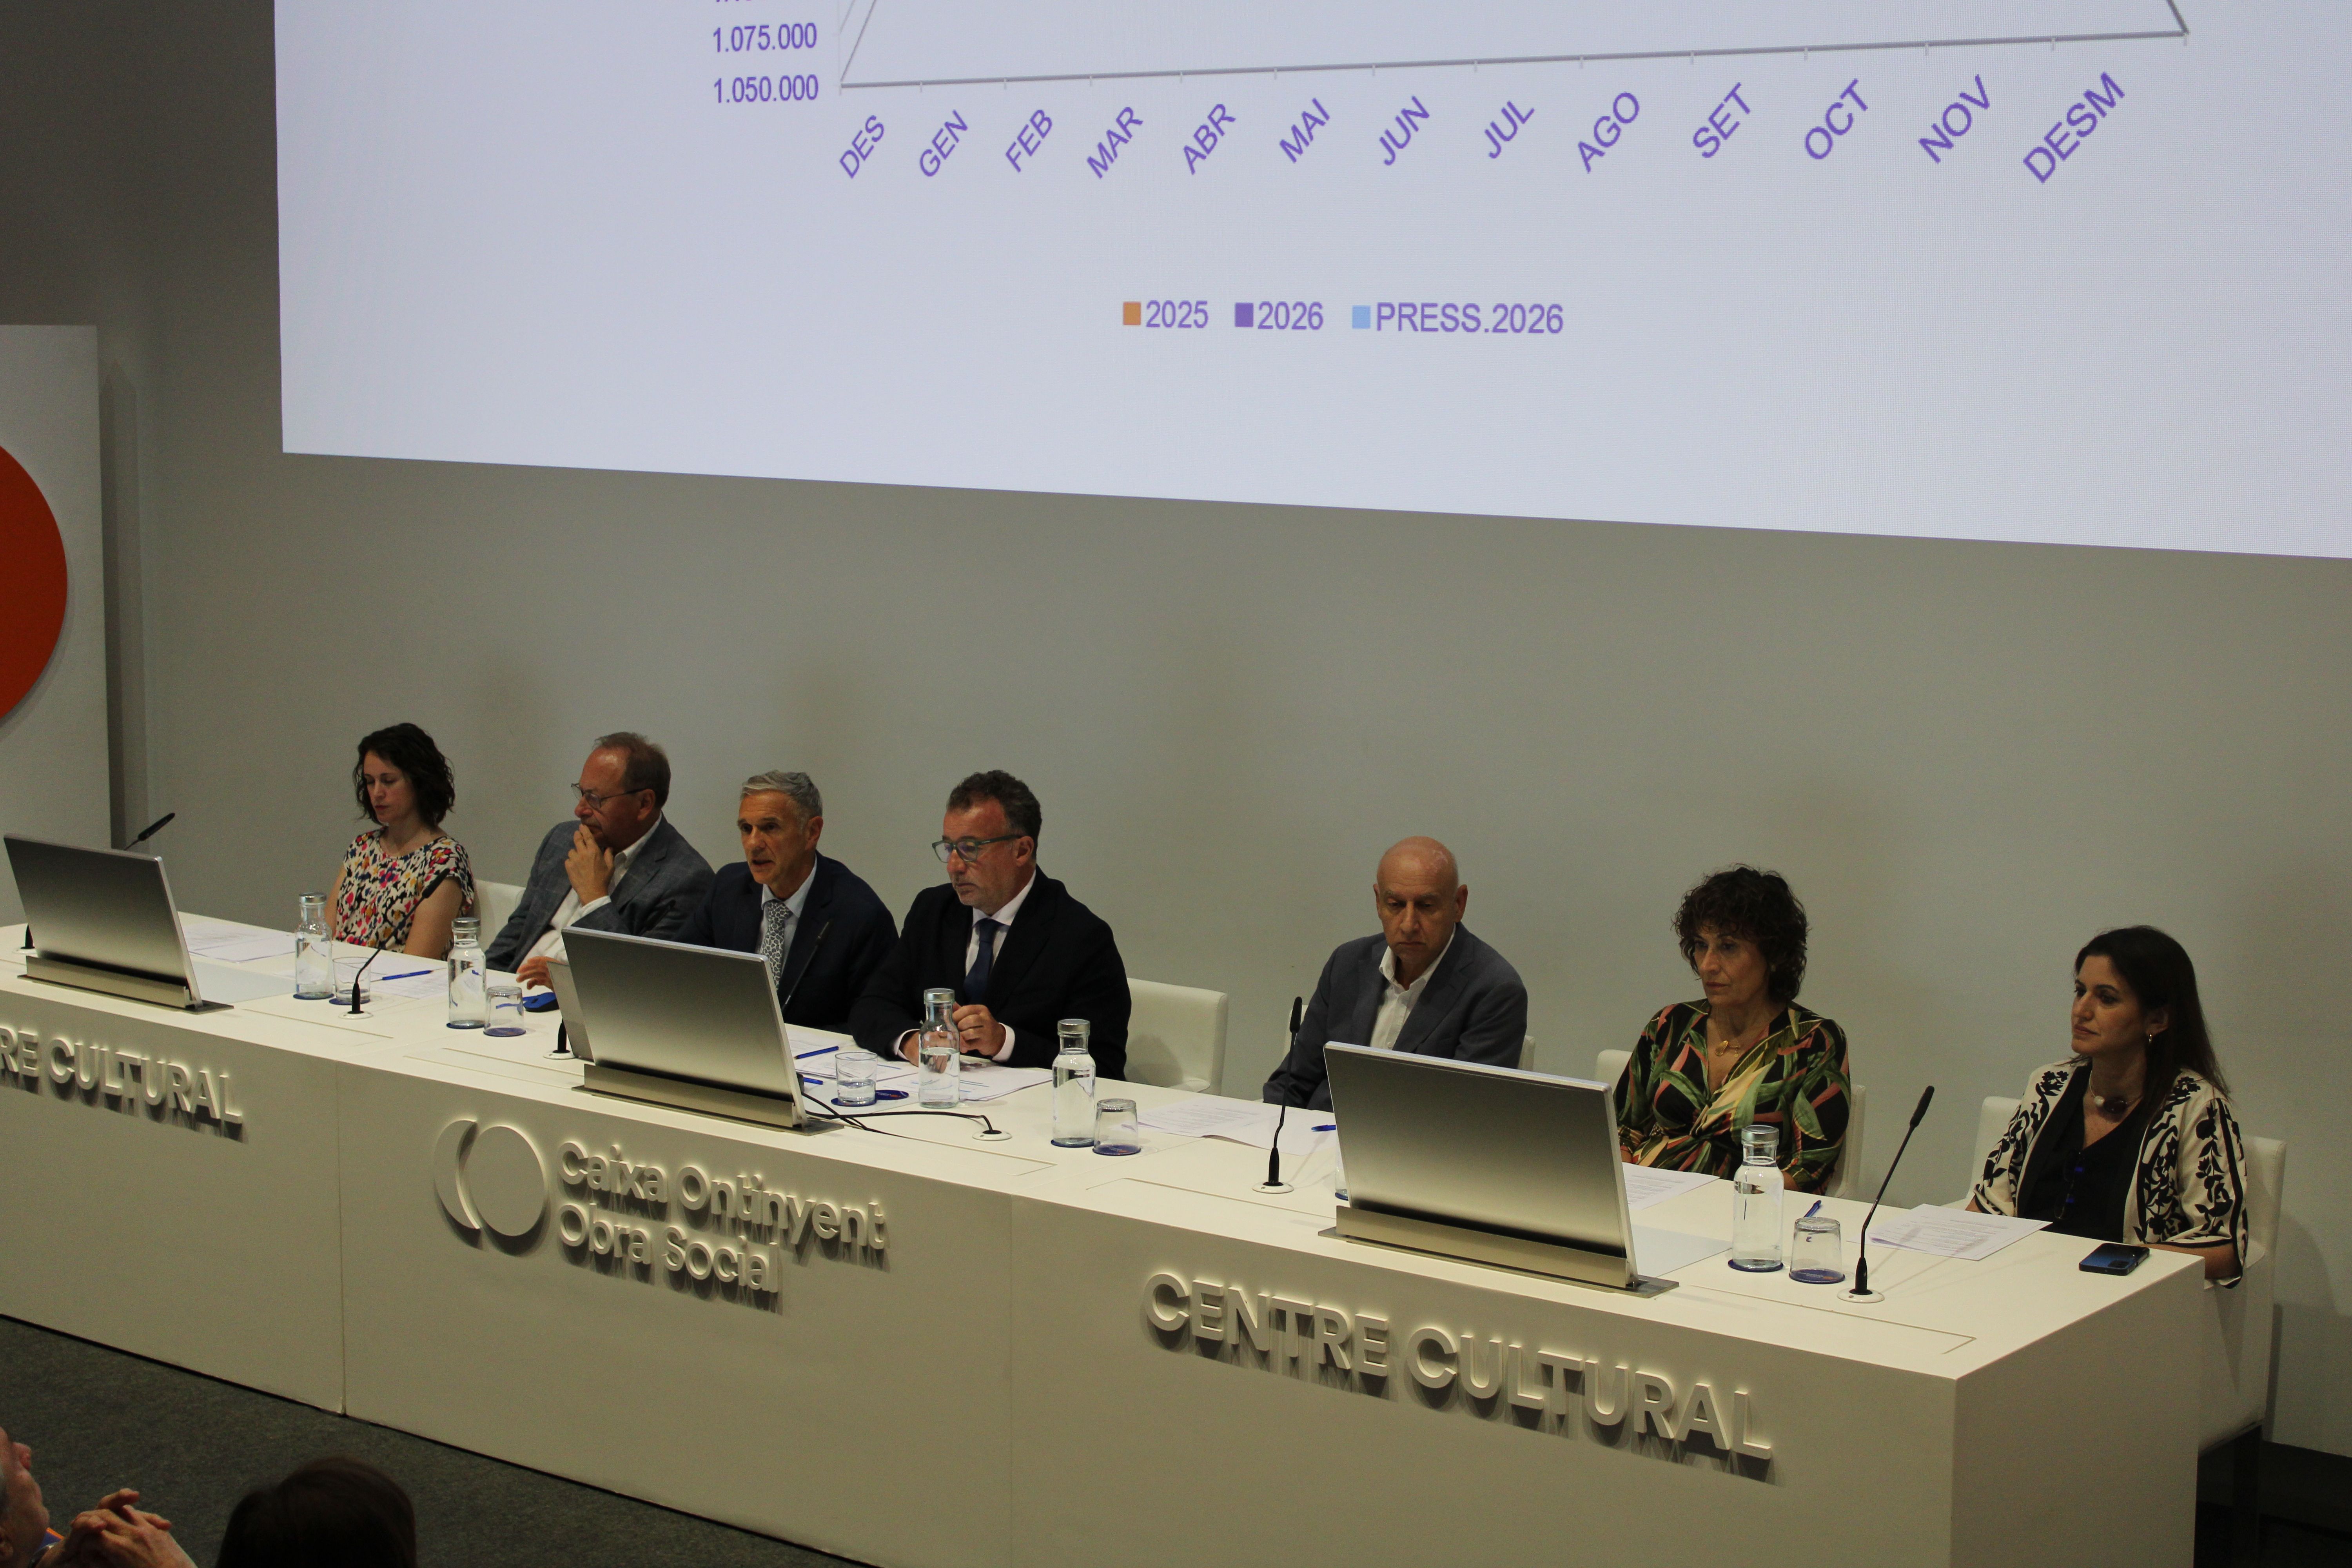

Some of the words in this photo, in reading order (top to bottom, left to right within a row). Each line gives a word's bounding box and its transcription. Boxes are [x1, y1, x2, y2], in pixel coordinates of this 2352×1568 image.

[713, 23, 817, 53] 1.075.000
[714, 74, 818, 103] 1.050.000
[1693, 82, 1750, 158] SET
[1805, 78, 1868, 160] OCT
[1918, 74, 1990, 163] NOV
[839, 115, 884, 178] DES
[920, 110, 968, 177] GEN
[1005, 110, 1052, 172] FEB
[1087, 107, 1143, 179] MAR
[1183, 104, 1236, 175] ABR
[1279, 98, 1330, 163] MAI
[1379, 96, 1430, 166] JUN
[1485, 101, 1535, 159] JUL
[1578, 92, 1640, 173] AGO
[2023, 72, 2125, 183] DESM
[1146, 300, 1208, 328] 2025
[1258, 301, 1323, 330] 2026
[1377, 303, 1563, 334] PRESS.2026
[49, 1038, 243, 1124] CULTURAL
[557, 1141, 668, 1203] Caixa
[677, 1165, 885, 1249] Ontinyent
[557, 1203, 651, 1265] Obra
[663, 1225, 779, 1293] Social
[1143, 1272, 1388, 1377] CENTRE
[1407, 1327, 1771, 1459] CULTURAL
